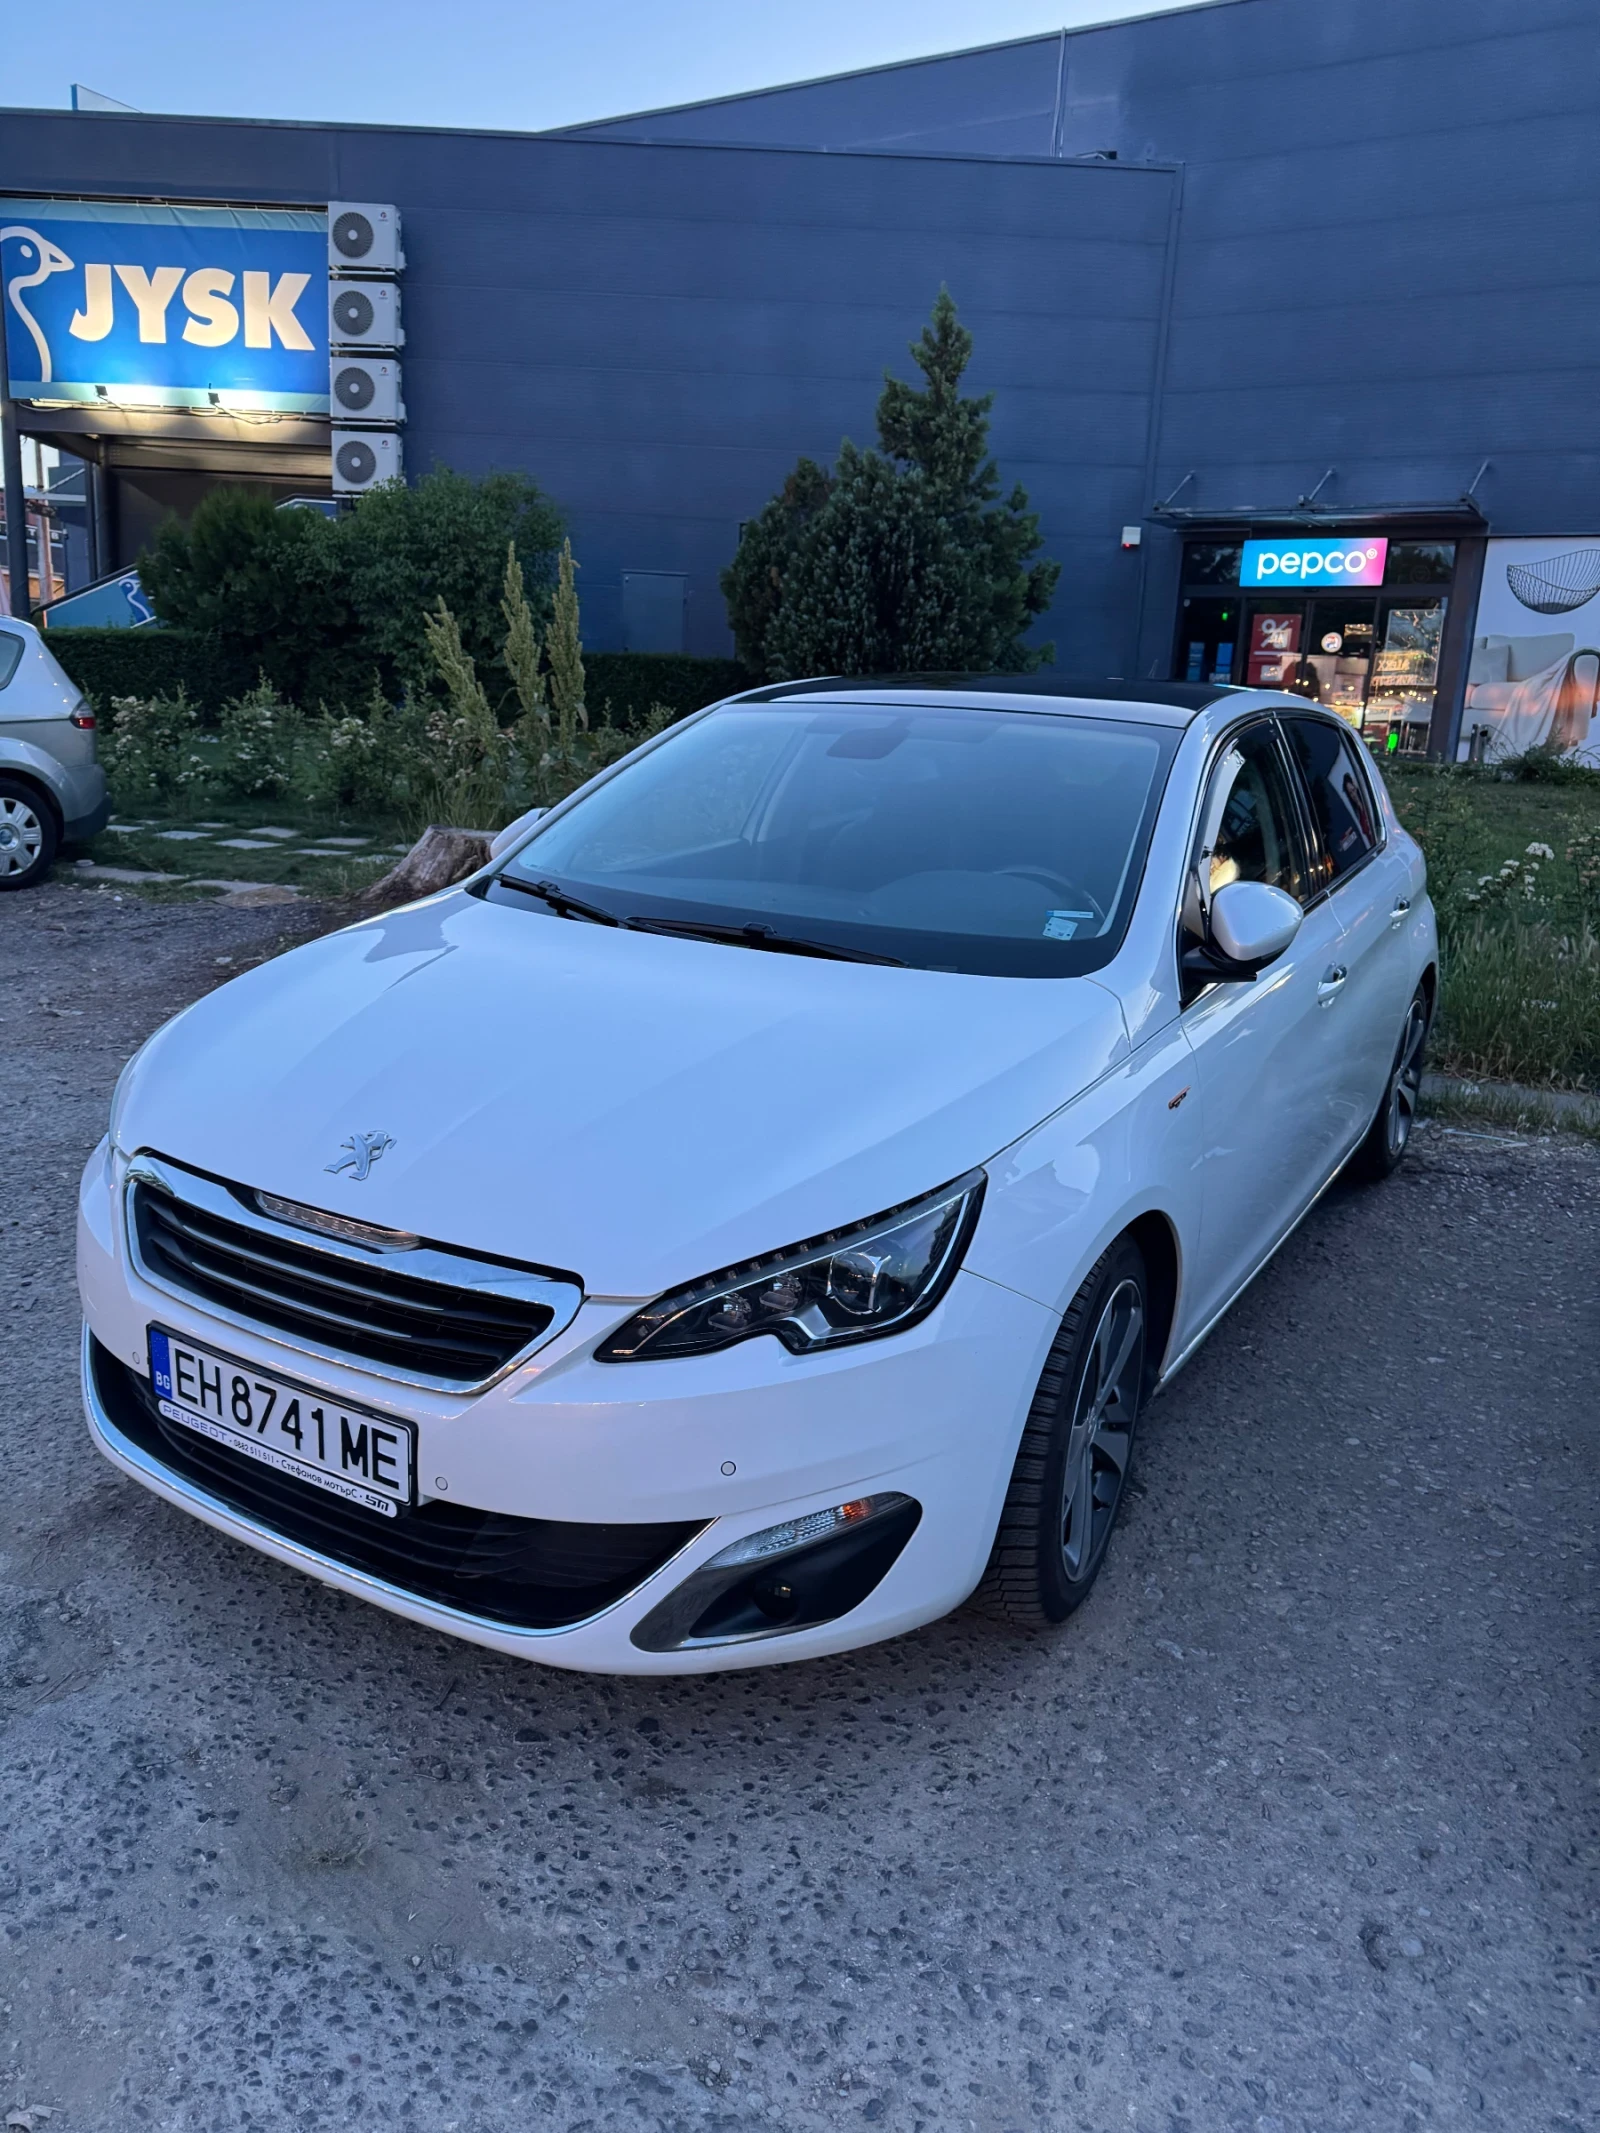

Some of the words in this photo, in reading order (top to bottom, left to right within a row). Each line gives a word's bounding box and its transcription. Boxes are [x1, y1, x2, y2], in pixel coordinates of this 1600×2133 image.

[69, 263, 316, 350] JYSK
[1257, 551, 1367, 580] pepco
[156, 1371, 170, 1389] BG
[163, 1404, 227, 1440] PEUGEOT
[281, 1460, 322, 1483] Стефанов
